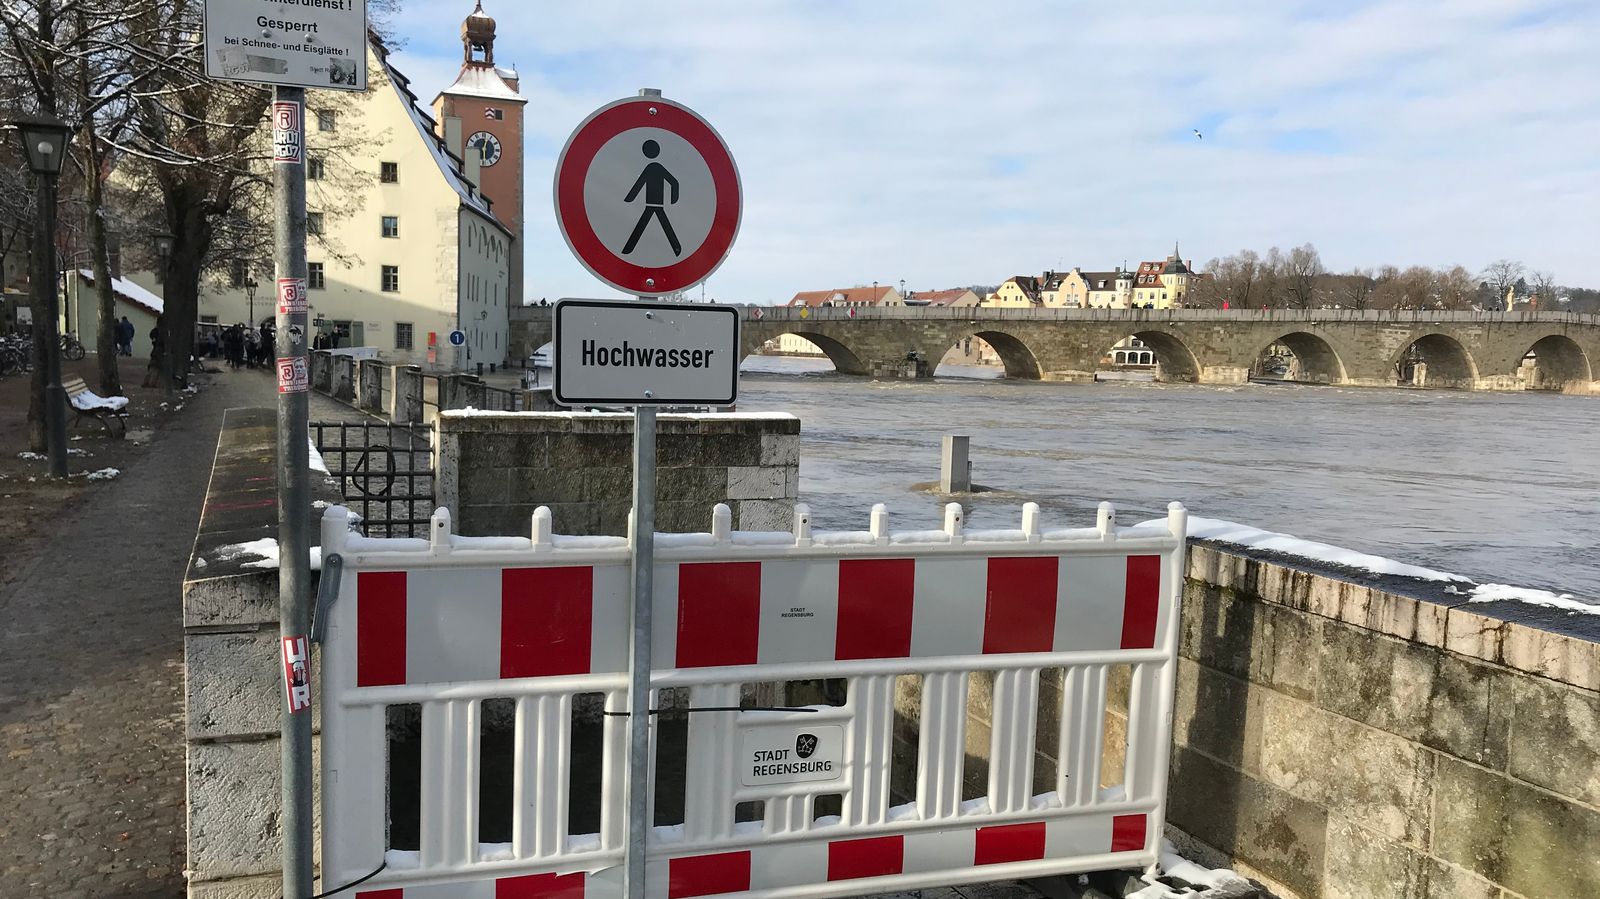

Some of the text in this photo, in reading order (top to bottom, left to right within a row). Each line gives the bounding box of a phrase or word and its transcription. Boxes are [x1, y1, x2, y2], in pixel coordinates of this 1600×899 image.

[256, 15, 318, 33] Gesperrt
[224, 36, 239, 46] bei
[242, 37, 281, 50] Schnee-
[283, 42, 301, 52] und
[304, 44, 343, 56] Eisglätte
[582, 339, 714, 369] Hochwasser
[753, 749, 790, 762] STADT
[753, 760, 832, 777] REGENSBURG
